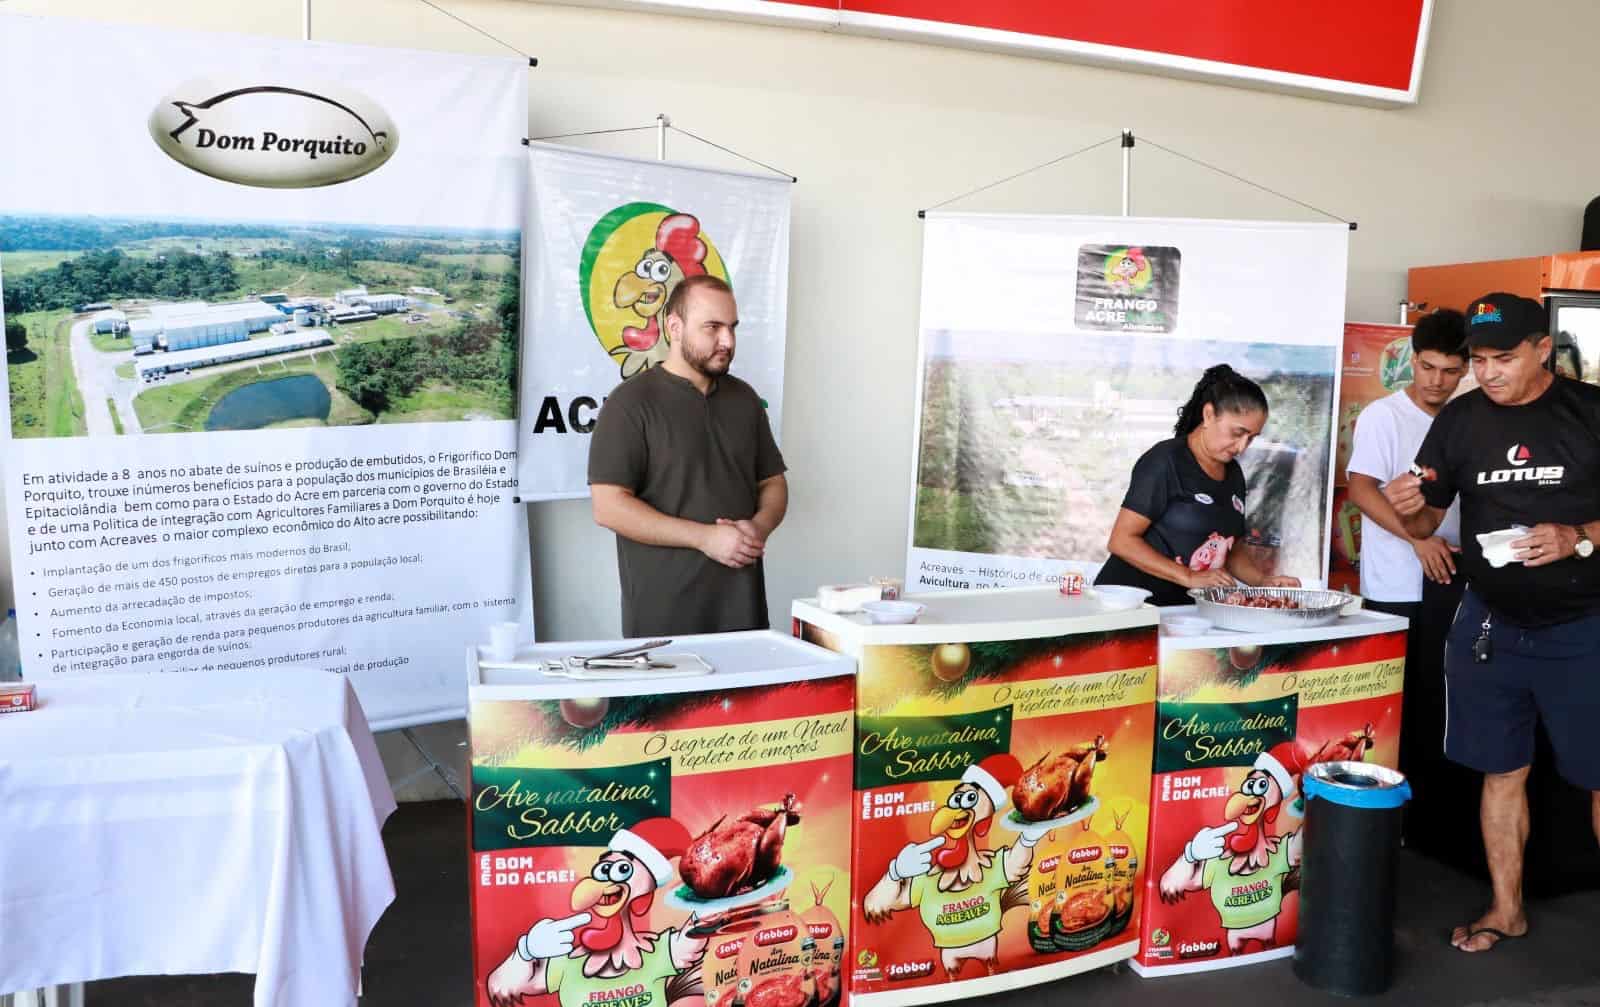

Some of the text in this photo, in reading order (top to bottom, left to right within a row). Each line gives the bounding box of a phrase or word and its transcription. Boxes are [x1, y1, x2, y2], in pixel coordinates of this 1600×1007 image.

[196, 128, 367, 159] Dom Porquito
[1094, 297, 1158, 311] FRANGO
[23, 451, 517, 484] Em atividade anos no abate de suínos produção de embutidos, Frigorífico Dom
[1477, 466, 1565, 485] LOTUS
[24, 465, 496, 502] Porquito, trouxe inúmeros benefícios para população dos municípios de Brasiléia
[25, 478, 518, 520] Epitaciolândia bem como para Estado do Acre em parceria com governo do Estado
[40, 493, 500, 533] de uma Política de integração com Agricultores Familiares Dom Porquito hoje
[29, 516, 400, 554] junto com Acreaves maior complexo econômico do Alto acre
[43, 561, 111, 577] Implantação
[114, 560, 128, 570] de
[131, 561, 148, 569] um
[152, 557, 170, 567] dos
[230, 550, 253, 560] mais
[256, 548, 306, 558] modernos
[309, 545, 320, 554] do
[920, 561, 1026, 580] Acreaves Histórico
[48, 556, 397, 596] Geração de mais de 450 postos de empregos diretos para população
[919, 575, 970, 589] Avicultura
[50, 593, 200, 616] Aumento da arrecadação de
[51, 623, 101, 637] Fomento
[105, 621, 119, 631] da
[122, 615, 172, 630] Economia
[176, 612, 202, 624] local,
[243, 607, 256, 616] da
[258, 603, 296, 616] geração
[299, 601, 310, 610] de
[313, 598, 354, 609] emprego
[51, 598, 515, 658] Participação geração renda para pequenos produtores agricultura familiar, com sistema
[70, 646, 200, 670] integração para engorda
[268, 649, 320, 666] produtores
[368, 656, 410, 671] produção
[994, 672, 1147, 703] O segredo Natal
[644, 718, 848, 755] O segredo de um Natal
[1163, 712, 1287, 740] Ave natalina
[860, 726, 998, 755] Ave natalina
[1185, 735, 1266, 762] Sabbor
[680, 739, 818, 770] repleto de emoções
[885, 750, 975, 778] Sabbor
[1173, 786, 1229, 801] DO ACRE!
[1174, 776, 1202, 788] BOM
[475, 779, 654, 811] Ave natalina
[874, 791, 905, 804] BOM
[874, 800, 936, 818] DO ACRE!
[507, 807, 624, 840] Sabbor
[495, 856, 533, 870] BOM
[495, 870, 575, 886] DO ACRE!
[1065, 870, 1103, 889] Natalina
[1231, 880, 1269, 896] FRANGO
[936, 902, 990, 926] ACREAVES
[943, 895, 985, 913] FRANGO
[757, 928, 794, 941] Sabbor
[749, 952, 801, 976] Natalina
[890, 960, 932, 976] Sabbor
[589, 984, 645, 1001] FRANGO
